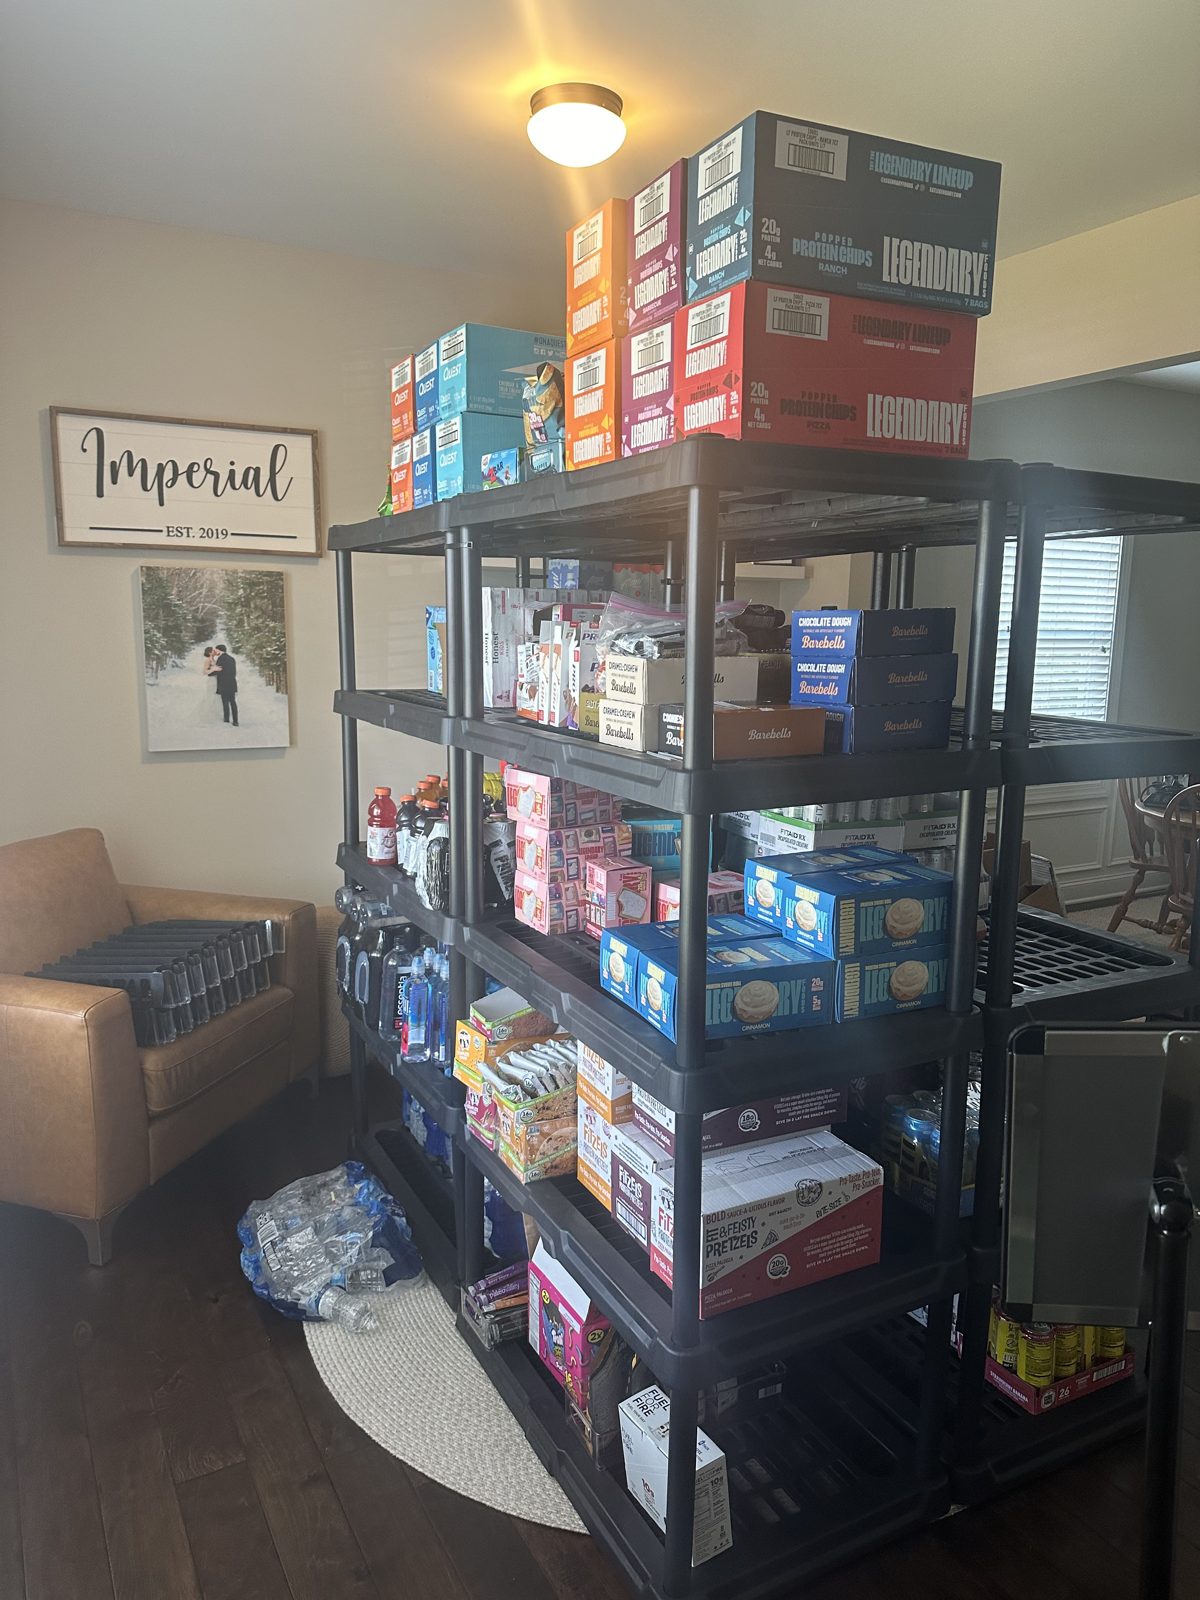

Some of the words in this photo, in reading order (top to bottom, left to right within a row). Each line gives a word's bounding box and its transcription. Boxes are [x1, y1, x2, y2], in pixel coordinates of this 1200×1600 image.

[874, 151, 932, 183] LEGENDARY
[932, 164, 974, 191] LINEUP
[698, 178, 737, 225] LEGENDARY
[761, 217, 781, 236] 20g
[761, 233, 781, 243] PROTEIN
[815, 231, 853, 247] POPPED
[696, 232, 737, 281] LEGENDARY
[764, 245, 777, 261] 4g
[792, 237, 839, 262] PROTEIN
[839, 245, 873, 268] CHIPS
[818, 262, 848, 275] RANCH
[882, 235, 985, 297] LEGENDARY
[635, 266, 669, 311] LEGENDARY
[685, 340, 726, 379] LEGENDARY
[418, 377, 435, 397] QUEST
[633, 366, 668, 400] LEGENDARY
[750, 381, 769, 398] 20g
[684, 393, 725, 432] LEGENDARY
[753, 407, 765, 422] 4g
[866, 393, 964, 444] LEGENDARY
[631, 415, 669, 450] LEGENDARY
[81, 427, 293, 507] Imperial
[166, 526, 195, 538] EST.
[199, 528, 229, 540] 2019
[798, 617, 831, 627] CHOCOLATE
[831, 616, 853, 627] DOUGH
[891, 624, 929, 637] Barebells
[801, 635, 846, 650] Barebells
[797, 663, 827, 673] CHOCOLATE
[826, 664, 846, 674] DOUGH
[887, 671, 928, 684] Barebells
[610, 678, 637, 696] Barebells
[799, 680, 839, 696] Barebells
[826, 711, 844, 722] DOUGH
[884, 719, 922, 732] Barebells
[605, 723, 635, 741] Barebells
[748, 728, 792, 741] Barebells
[780, 828, 798, 839] FITAID
[798, 833, 807, 842] RX
[923, 823, 947, 831] FITAID
[845, 833, 866, 841] FITAID
[840, 899, 856, 953] LEGENDARY
[860, 896, 944, 942] LEGRY
[891, 939, 918, 948] CINNAMON
[811, 977, 824, 987] 20g
[844, 962, 860, 1014] LEGENDARY
[705, 979, 801, 1026] LEGRY
[896, 999, 922, 1009] CINNAMON
[741, 1022, 771, 1033] CINNAMON
[706, 1210, 726, 1225] BOLD
[727, 1200, 767, 1219] SAUCE-A-LICIOUS
[767, 1197, 786, 1208] FLAVOR
[815, 1197, 842, 1218] BITE-SIZE
[658, 1206, 674, 1237] FiTZ
[706, 1227, 719, 1243] FIT
[719, 1226, 728, 1239] &
[727, 1216, 757, 1236] FEISTY
[706, 1230, 759, 1258] PRETZELS
[705, 1261, 717, 1269] PIZZA
[717, 1257, 734, 1266] PALOOZA
[488, 1282, 520, 1299] paleovalley
[704, 1293, 716, 1301] PIZZA
[716, 1287, 733, 1296] PALOOZA
[640, 1392, 660, 1411] FOR
[648, 1388, 670, 1412] FUEL
[1059, 1386, 1071, 1399] 26
[632, 1397, 654, 1417] FIRE
